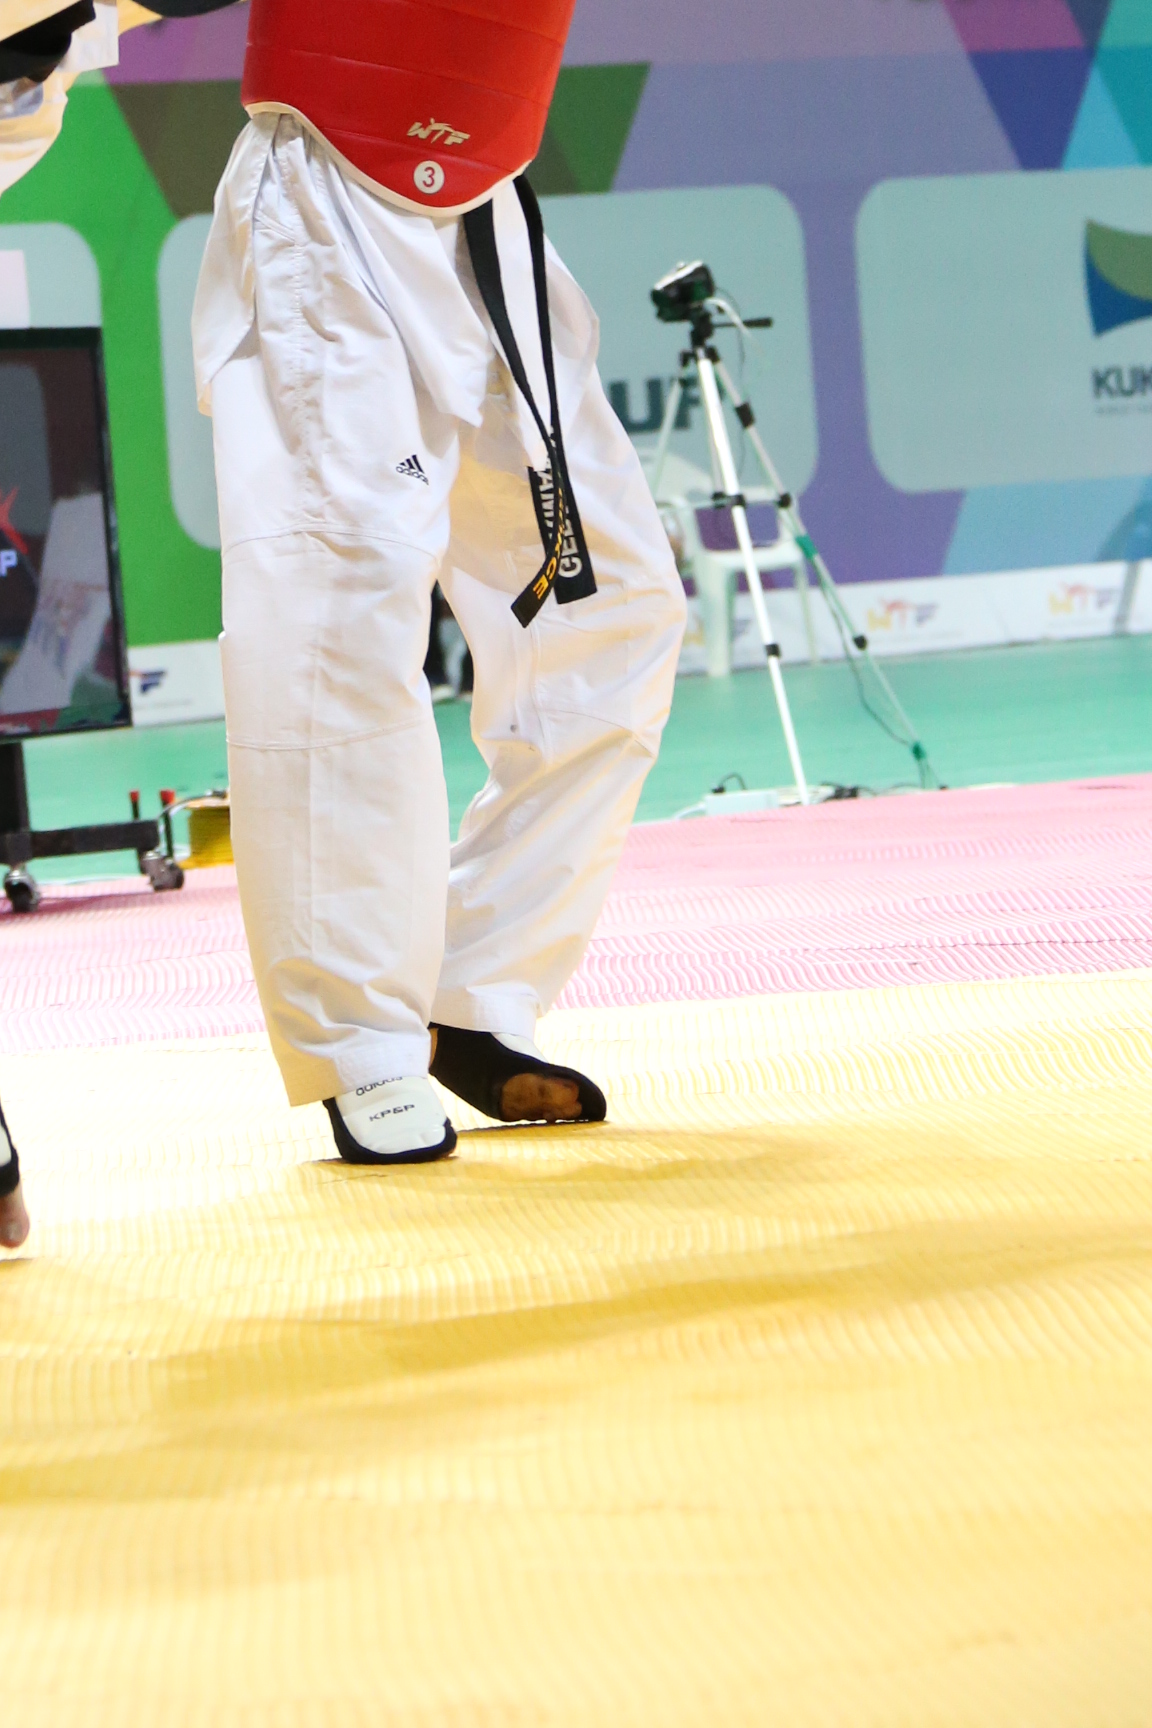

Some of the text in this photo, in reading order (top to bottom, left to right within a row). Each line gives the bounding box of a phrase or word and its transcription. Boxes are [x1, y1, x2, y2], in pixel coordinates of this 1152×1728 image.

[407, 117, 470, 145] WTF
[422, 166, 436, 188] 3
[369, 1104, 415, 1122] KP&P
